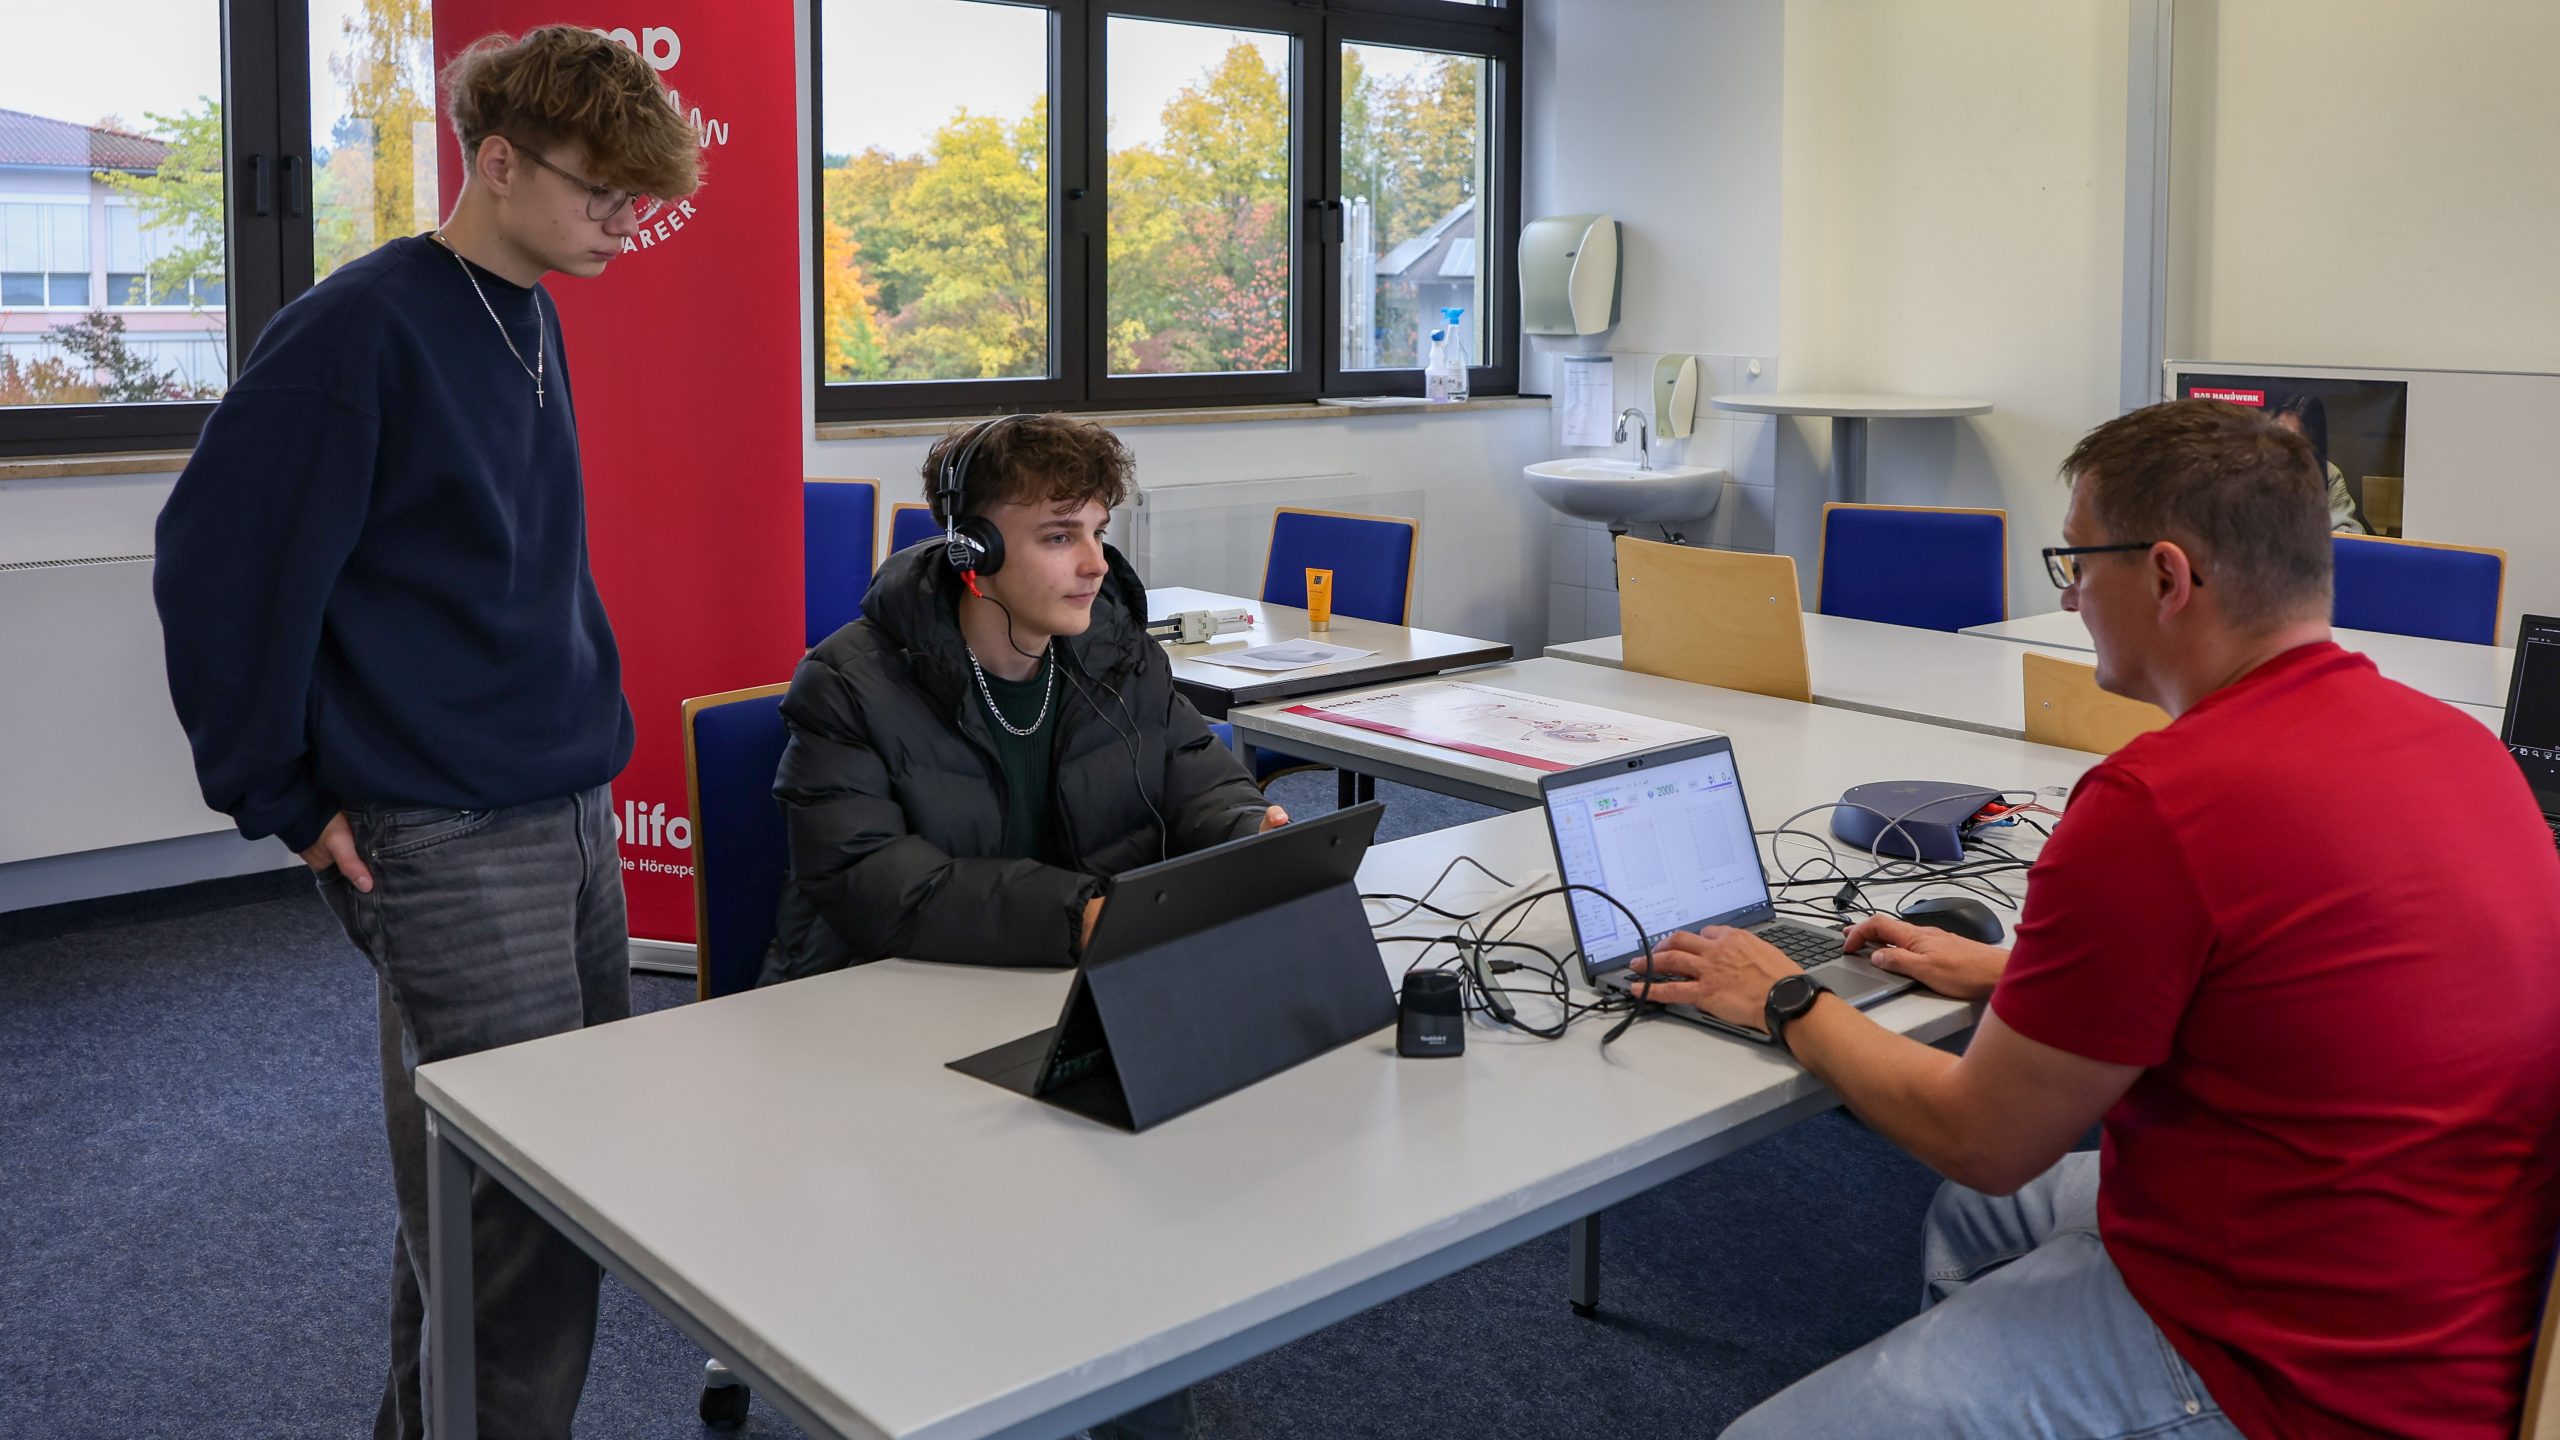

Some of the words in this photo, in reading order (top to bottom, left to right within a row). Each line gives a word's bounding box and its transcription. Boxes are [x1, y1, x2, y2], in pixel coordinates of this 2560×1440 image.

[620, 199, 697, 254] AREER
[2212, 391, 2259, 402] HANDWERK
[613, 799, 692, 849] lifo
